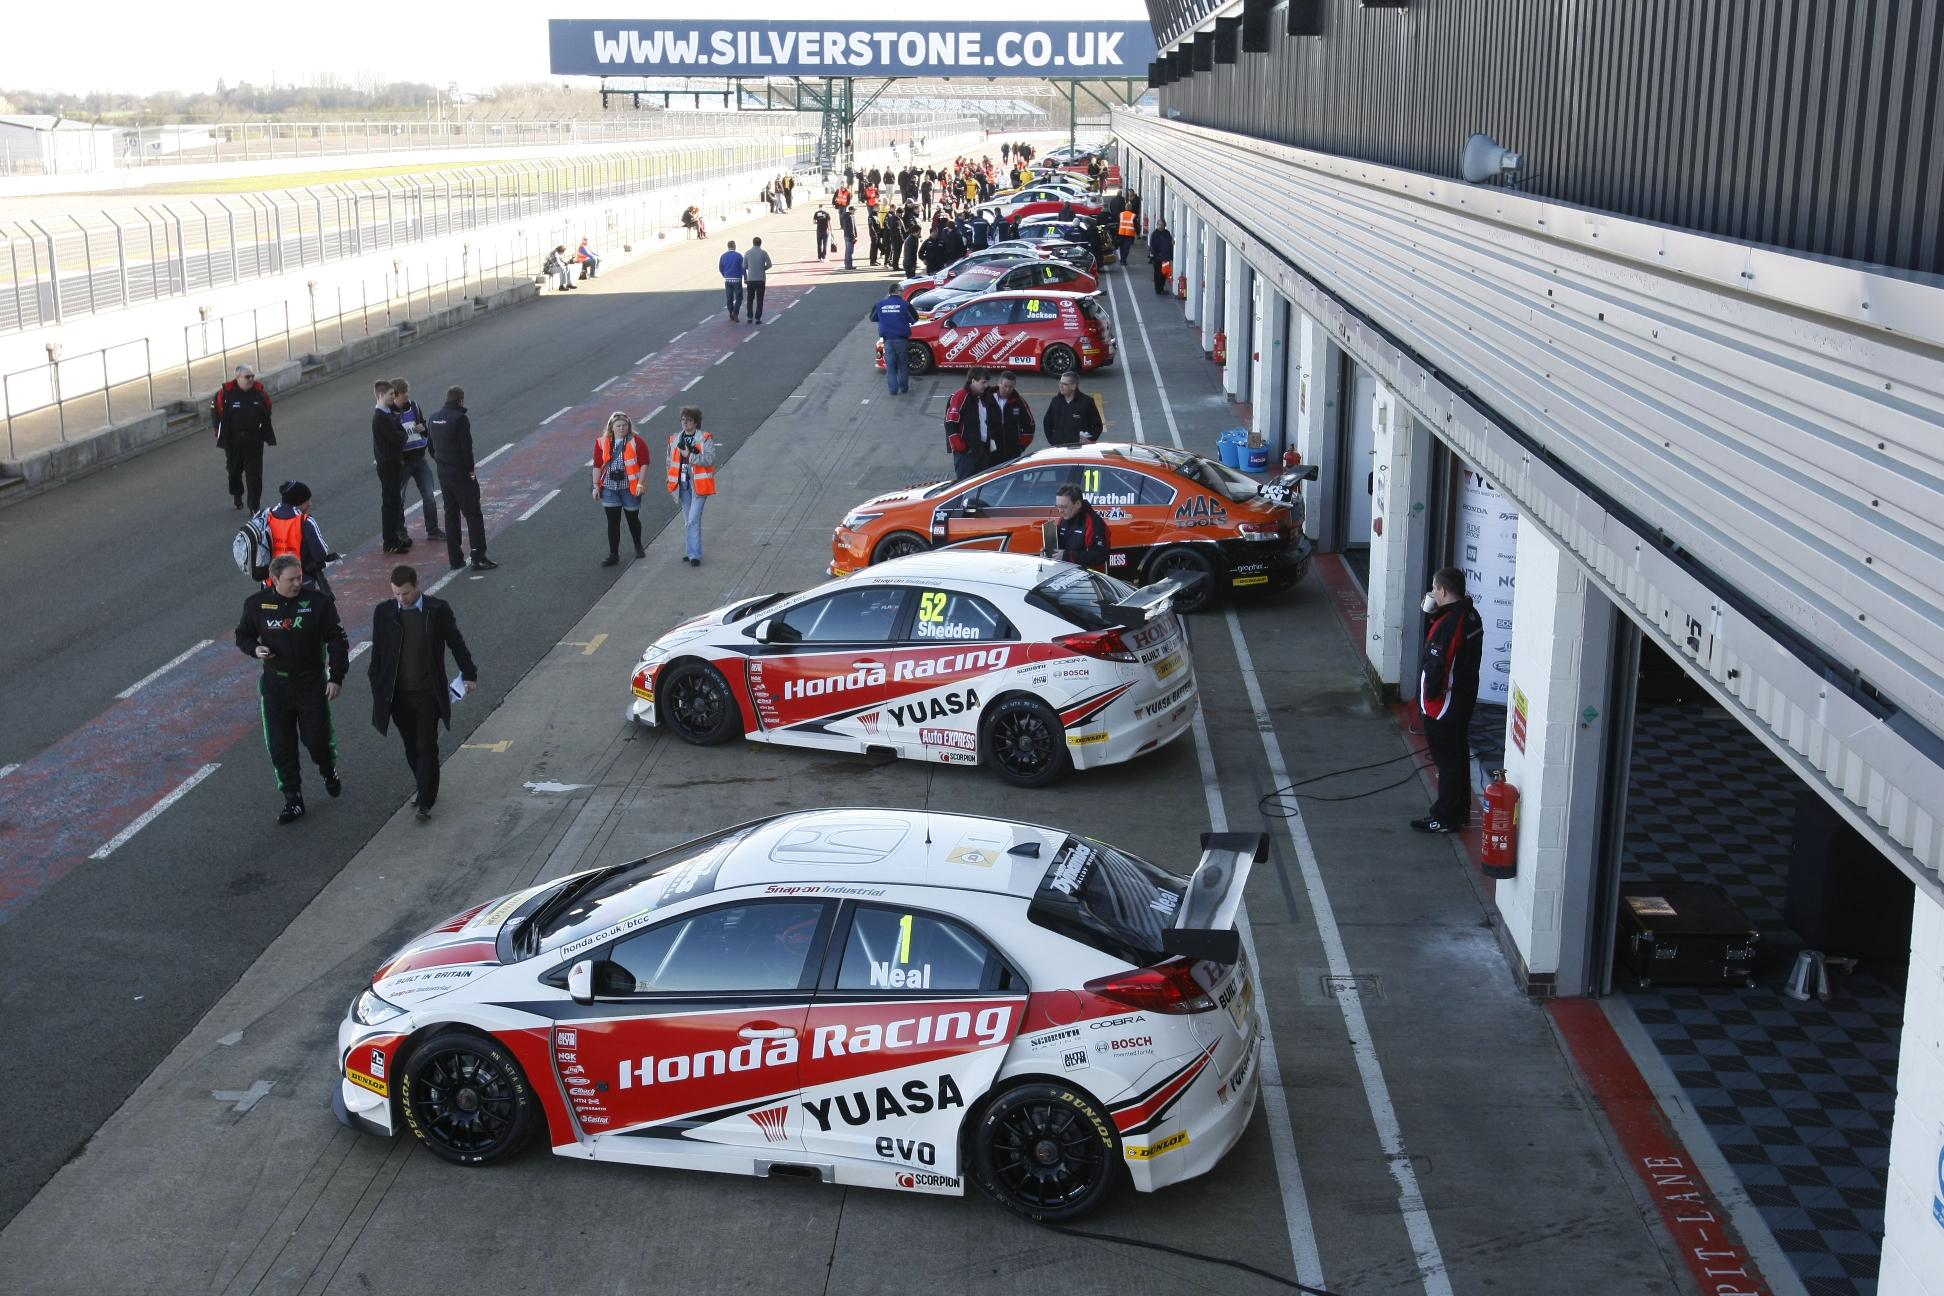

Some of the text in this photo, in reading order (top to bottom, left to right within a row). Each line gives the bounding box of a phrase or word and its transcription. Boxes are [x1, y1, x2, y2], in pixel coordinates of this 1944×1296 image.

[593, 30, 1125, 67] WWW.SILVERSTONE.CO.UK
[1045, 266, 1052, 278] 6
[1027, 299, 1040, 312] 48
[1027, 311, 1057, 319] Jackson
[945, 328, 980, 360] CORBEAU
[1014, 356, 1031, 364] evo
[1084, 470, 1099, 492] 11
[1082, 492, 1134, 504] Wrathall
[1260, 485, 1289, 500] K&N
[1175, 495, 1228, 519] MAC
[1462, 504, 1488, 515] HONDA
[1175, 516, 1228, 528] TOOLS
[1110, 554, 1126, 566] RESS
[919, 592, 947, 622] 52
[918, 622, 980, 640] Shedden
[1053, 658, 1088, 666] COBRA
[1140, 649, 1160, 664] BUILT
[784, 646, 1010, 700] Honda Racing
[888, 688, 982, 728] YUASA
[1146, 696, 1171, 717] YUASA
[922, 731, 975, 750] Auto EXPRESS
[1074, 734, 1107, 743] DUNLOP
[950, 752, 976, 763] SCORPION
[764, 885, 886, 897] Snap-on Industrial
[1150, 886, 1180, 916] Neal
[562, 915, 650, 956] honda.co.uk/btcc
[899, 914, 914, 964] 1
[396, 970, 473, 985] BUILT IN BRITAIN
[870, 961, 931, 990] Neal
[1218, 978, 1238, 1010] BUILT
[1090, 1015, 1147, 1030] COBRA
[558, 1032, 575, 1040] AUTO
[558, 1038, 575, 1046] GLYM
[1030, 1028, 1080, 1047] SCHROTH
[1111, 1036, 1153, 1050] BOSCH
[619, 1005, 1012, 1090] Honda Racing
[1064, 1050, 1086, 1060] AUTO
[558, 1052, 576, 1060] NGK
[1065, 1056, 1087, 1068] GLYM
[351, 1072, 385, 1091] DUNLOP
[402, 1074, 426, 1138] DUNLOP
[801, 1073, 965, 1132] YUASA
[587, 1116, 609, 1124] Castrol
[1060, 1092, 1113, 1149] DUNLOP
[876, 1136, 936, 1166] evo
[1140, 1134, 1186, 1158] DUNLOP
[916, 1174, 960, 1188] SCORPION
[1644, 1157, 1760, 1296] PIT-LANE
